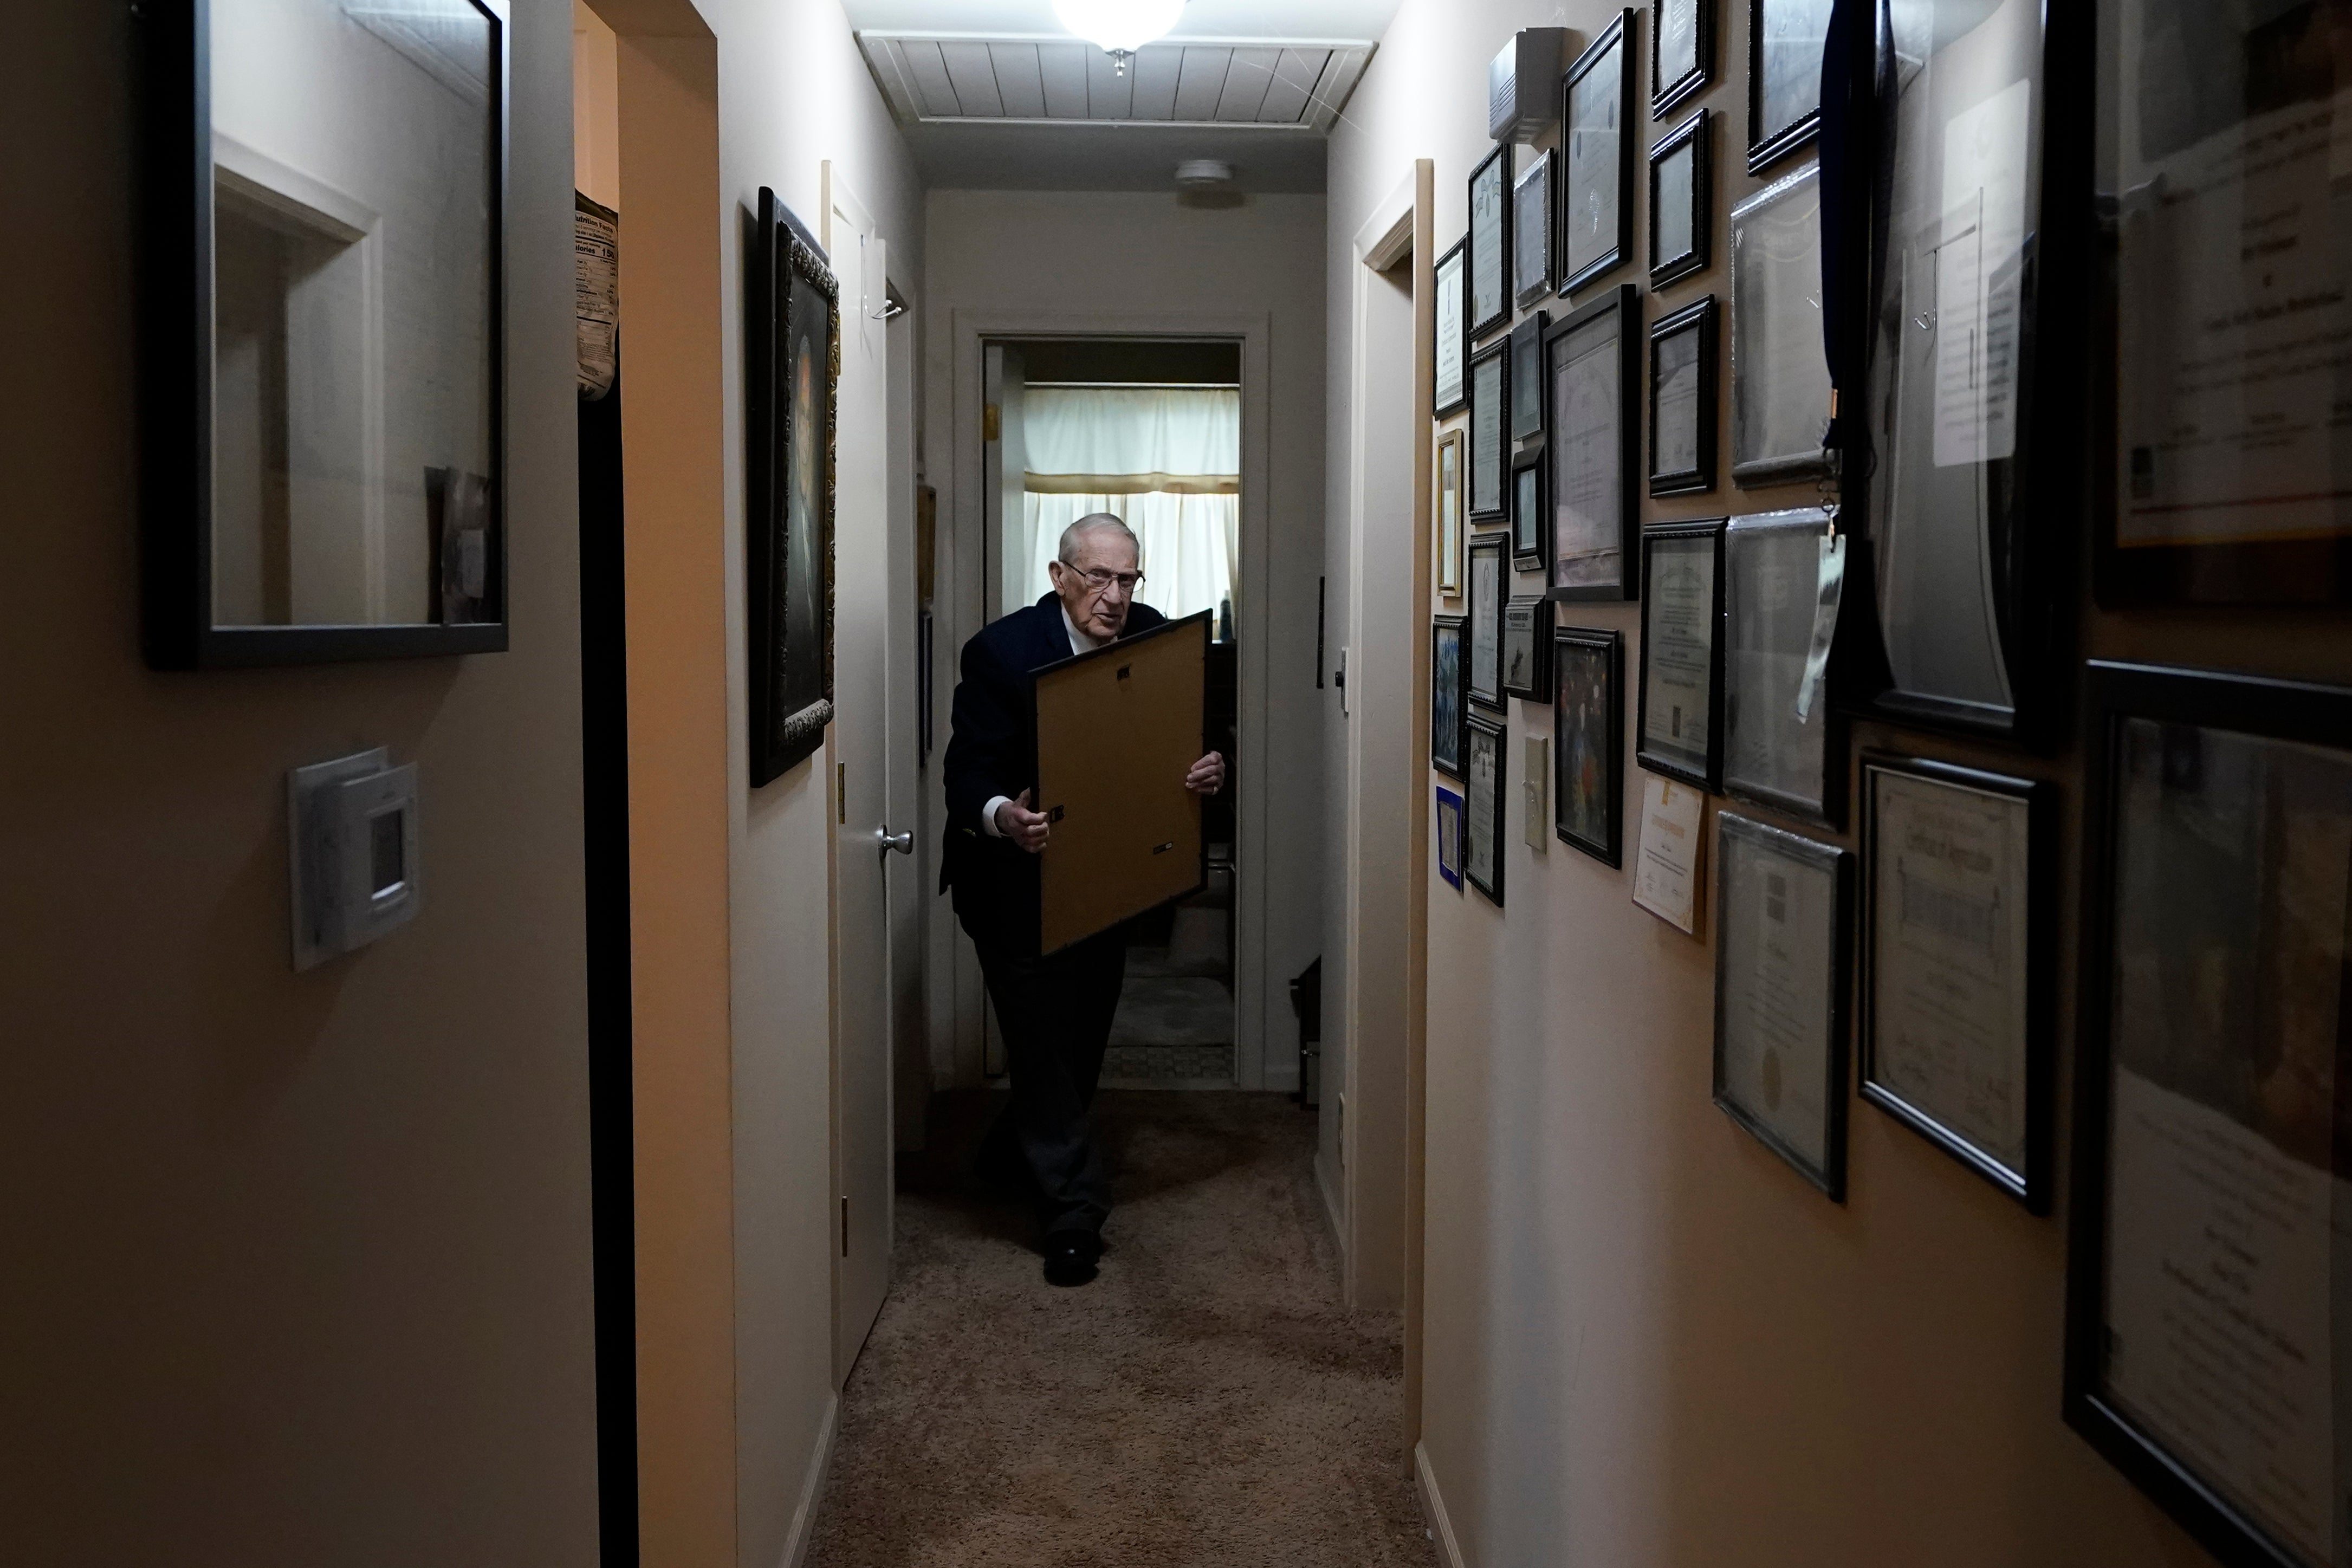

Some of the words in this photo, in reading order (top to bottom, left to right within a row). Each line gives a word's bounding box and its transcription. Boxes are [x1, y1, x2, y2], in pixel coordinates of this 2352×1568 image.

[575, 214, 598, 227] utrition
[599, 222, 613, 233] Facts
[575, 244, 595, 254] lories
